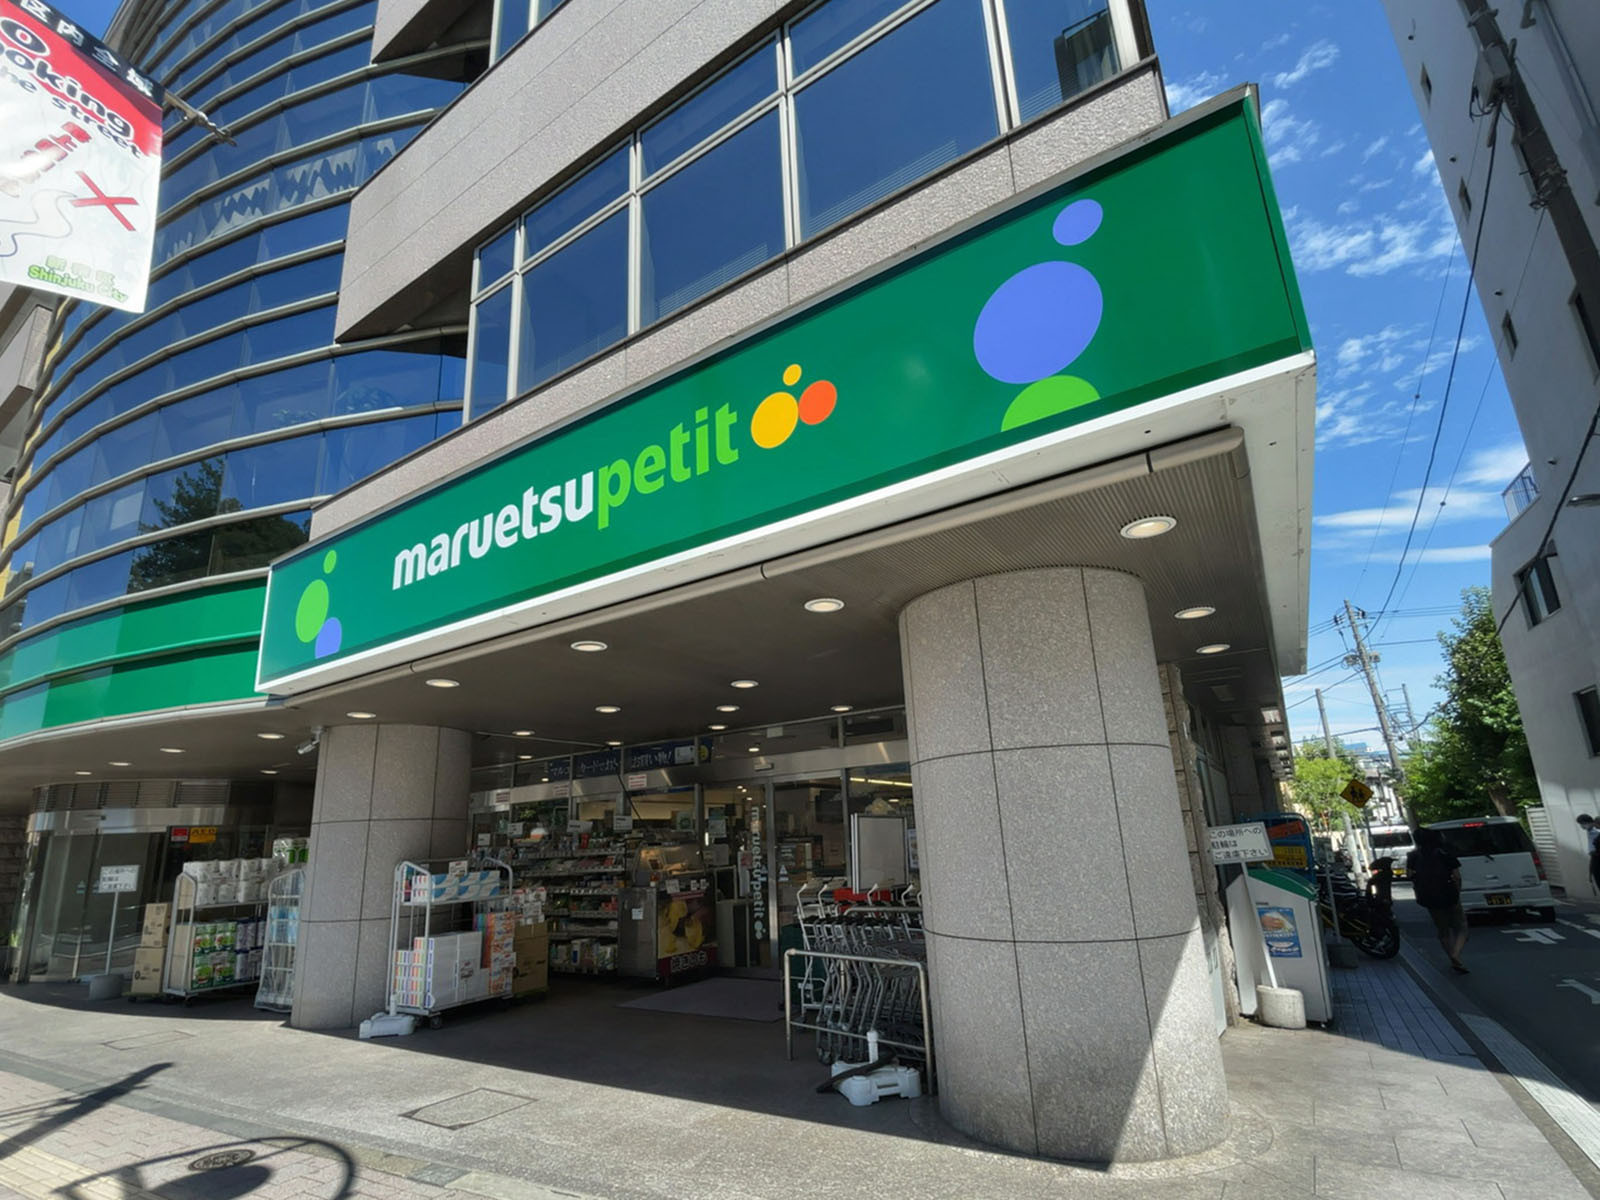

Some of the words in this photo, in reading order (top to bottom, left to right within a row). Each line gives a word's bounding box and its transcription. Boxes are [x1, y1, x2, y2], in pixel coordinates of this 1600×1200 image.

[0, 41, 134, 141] oking
[51, 97, 142, 158] street
[27, 264, 95, 293] Shinjuku
